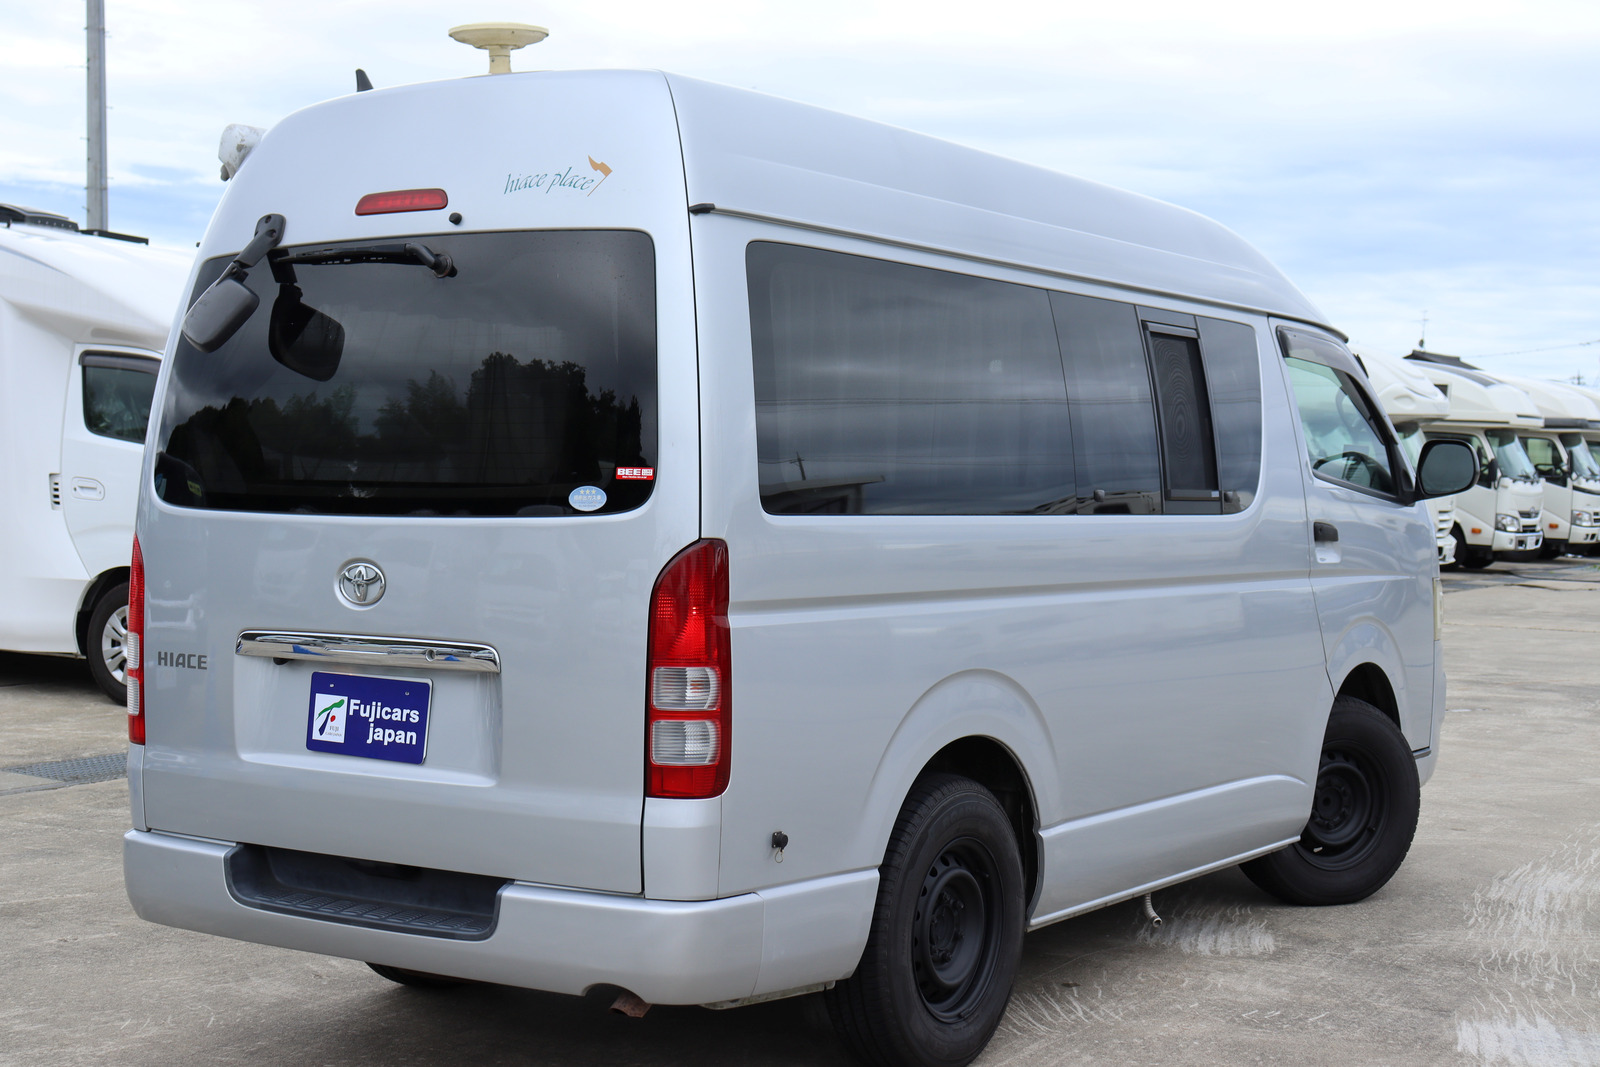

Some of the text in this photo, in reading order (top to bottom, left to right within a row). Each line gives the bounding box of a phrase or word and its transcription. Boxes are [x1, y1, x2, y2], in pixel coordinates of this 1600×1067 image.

[504, 166, 594, 195] hiace place
[158, 651, 207, 670] HIACE
[349, 699, 420, 723] Fujicars
[366, 723, 417, 746] japan
